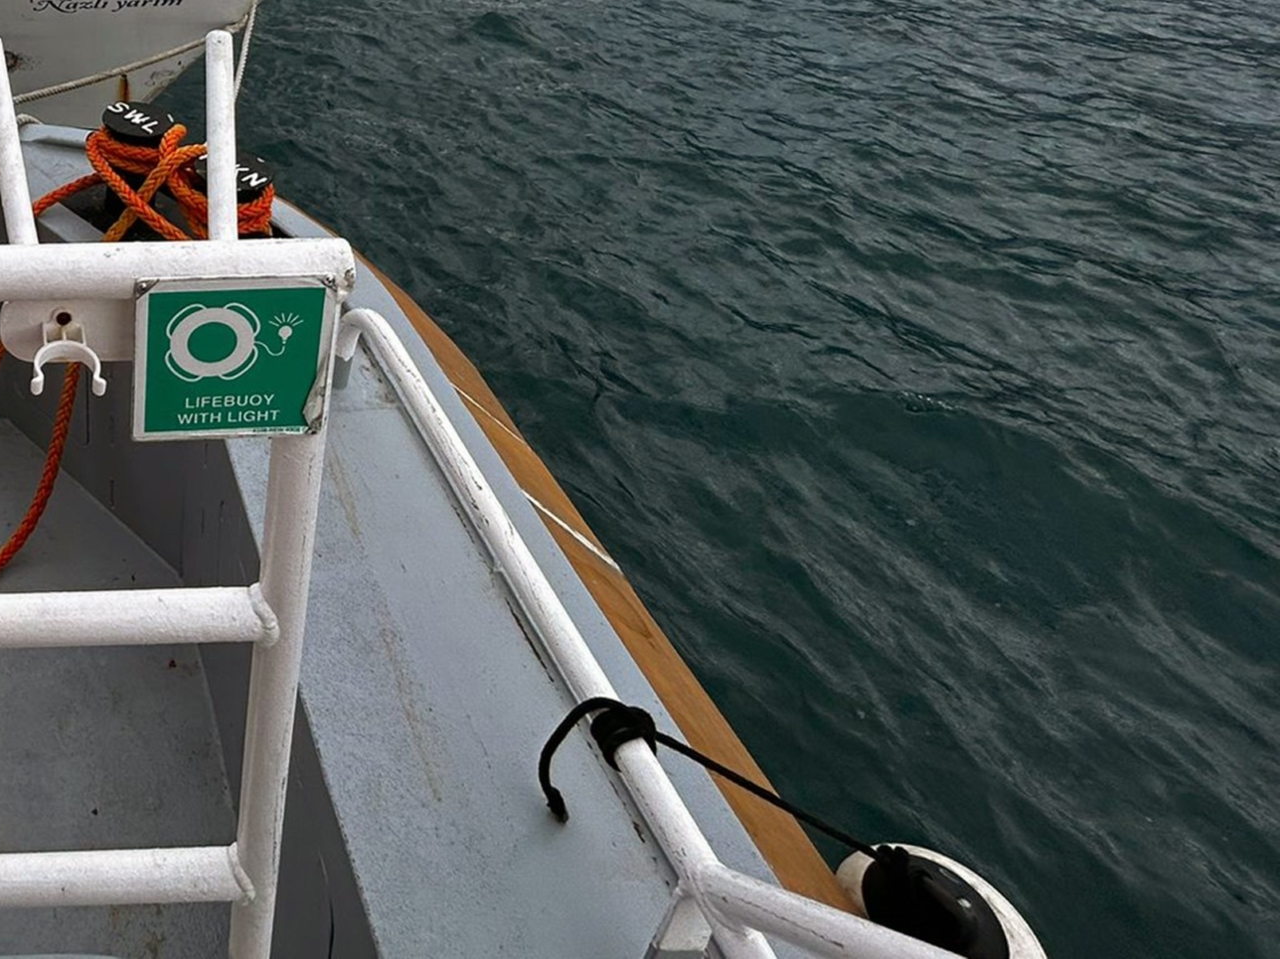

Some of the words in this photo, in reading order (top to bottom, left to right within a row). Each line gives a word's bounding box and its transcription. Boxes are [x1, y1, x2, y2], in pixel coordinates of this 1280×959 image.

[107, 102, 159, 135] SWL
[184, 394, 275, 408] LIFEBUOY
[177, 411, 223, 425] WITH
[227, 409, 281, 423] LIGHT
